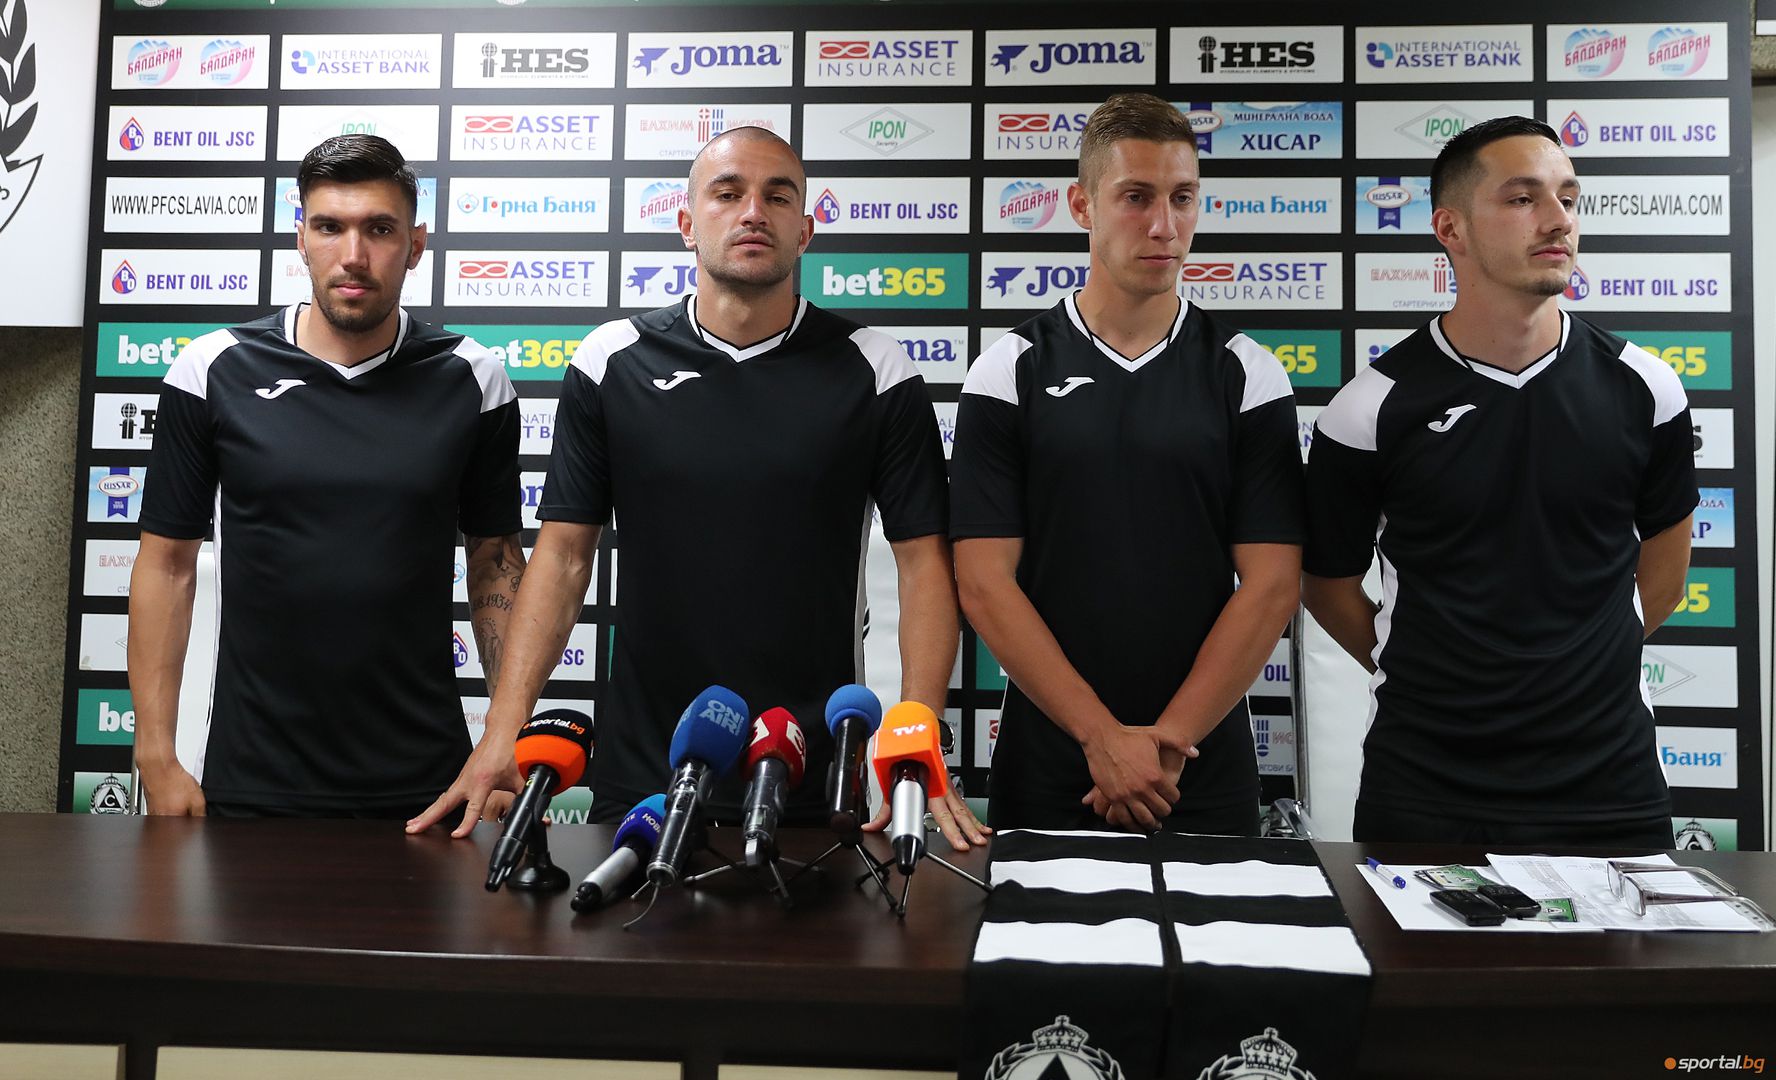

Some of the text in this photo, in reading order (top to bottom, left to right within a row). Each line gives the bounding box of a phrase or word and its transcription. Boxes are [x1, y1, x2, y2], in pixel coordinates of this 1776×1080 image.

[872, 40, 959, 59] ASSET
[1395, 40, 1520, 52] INTERNATIONAL
[1565, 35, 1627, 67] БАЛДАРАН
[1648, 34, 1710, 66] БАЛДАРАН
[128, 46, 182, 75] БАЛДАРАН
[200, 46, 255, 75] БАЛДАРАН
[317, 50, 430, 60] INTERNATIONAL
[1395, 52, 1521, 68] ASSET BANK
[317, 61, 430, 74] ASSET BANK
[818, 62, 956, 77] INSURANCE
[515, 116, 600, 133] ASSET
[1304, 112, 1334, 121] ВОДА
[868, 121, 906, 138] IPON
[1600, 125, 1716, 142] BENT OIL JSC
[154, 131, 255, 146] BENT OIL JSC
[463, 137, 597, 151] INSURANCE
[111, 195, 258, 215] WWW.PFCSLAVIA.COM
[544, 196, 596, 213] Баня
[641, 192, 689, 219] БАЛДАРА
[850, 203, 958, 219] BENT OIL JSC
[1000, 188, 1059, 219] БАЛДАРАН
[1205, 196, 1327, 218] Горна Баня
[510, 261, 595, 279] ASSET
[1237, 263, 1328, 281] ASSET
[146, 275, 248, 290] BENT OIL JSC
[822, 265, 946, 296] bet365
[1601, 279, 1718, 296] BENT OIL JSC
[458, 282, 592, 297] INSURANCE
[1181, 285, 1325, 300] INSURANCE
[1265, 665, 1290, 681] OIL
[1662, 746, 1721, 766] Баня
